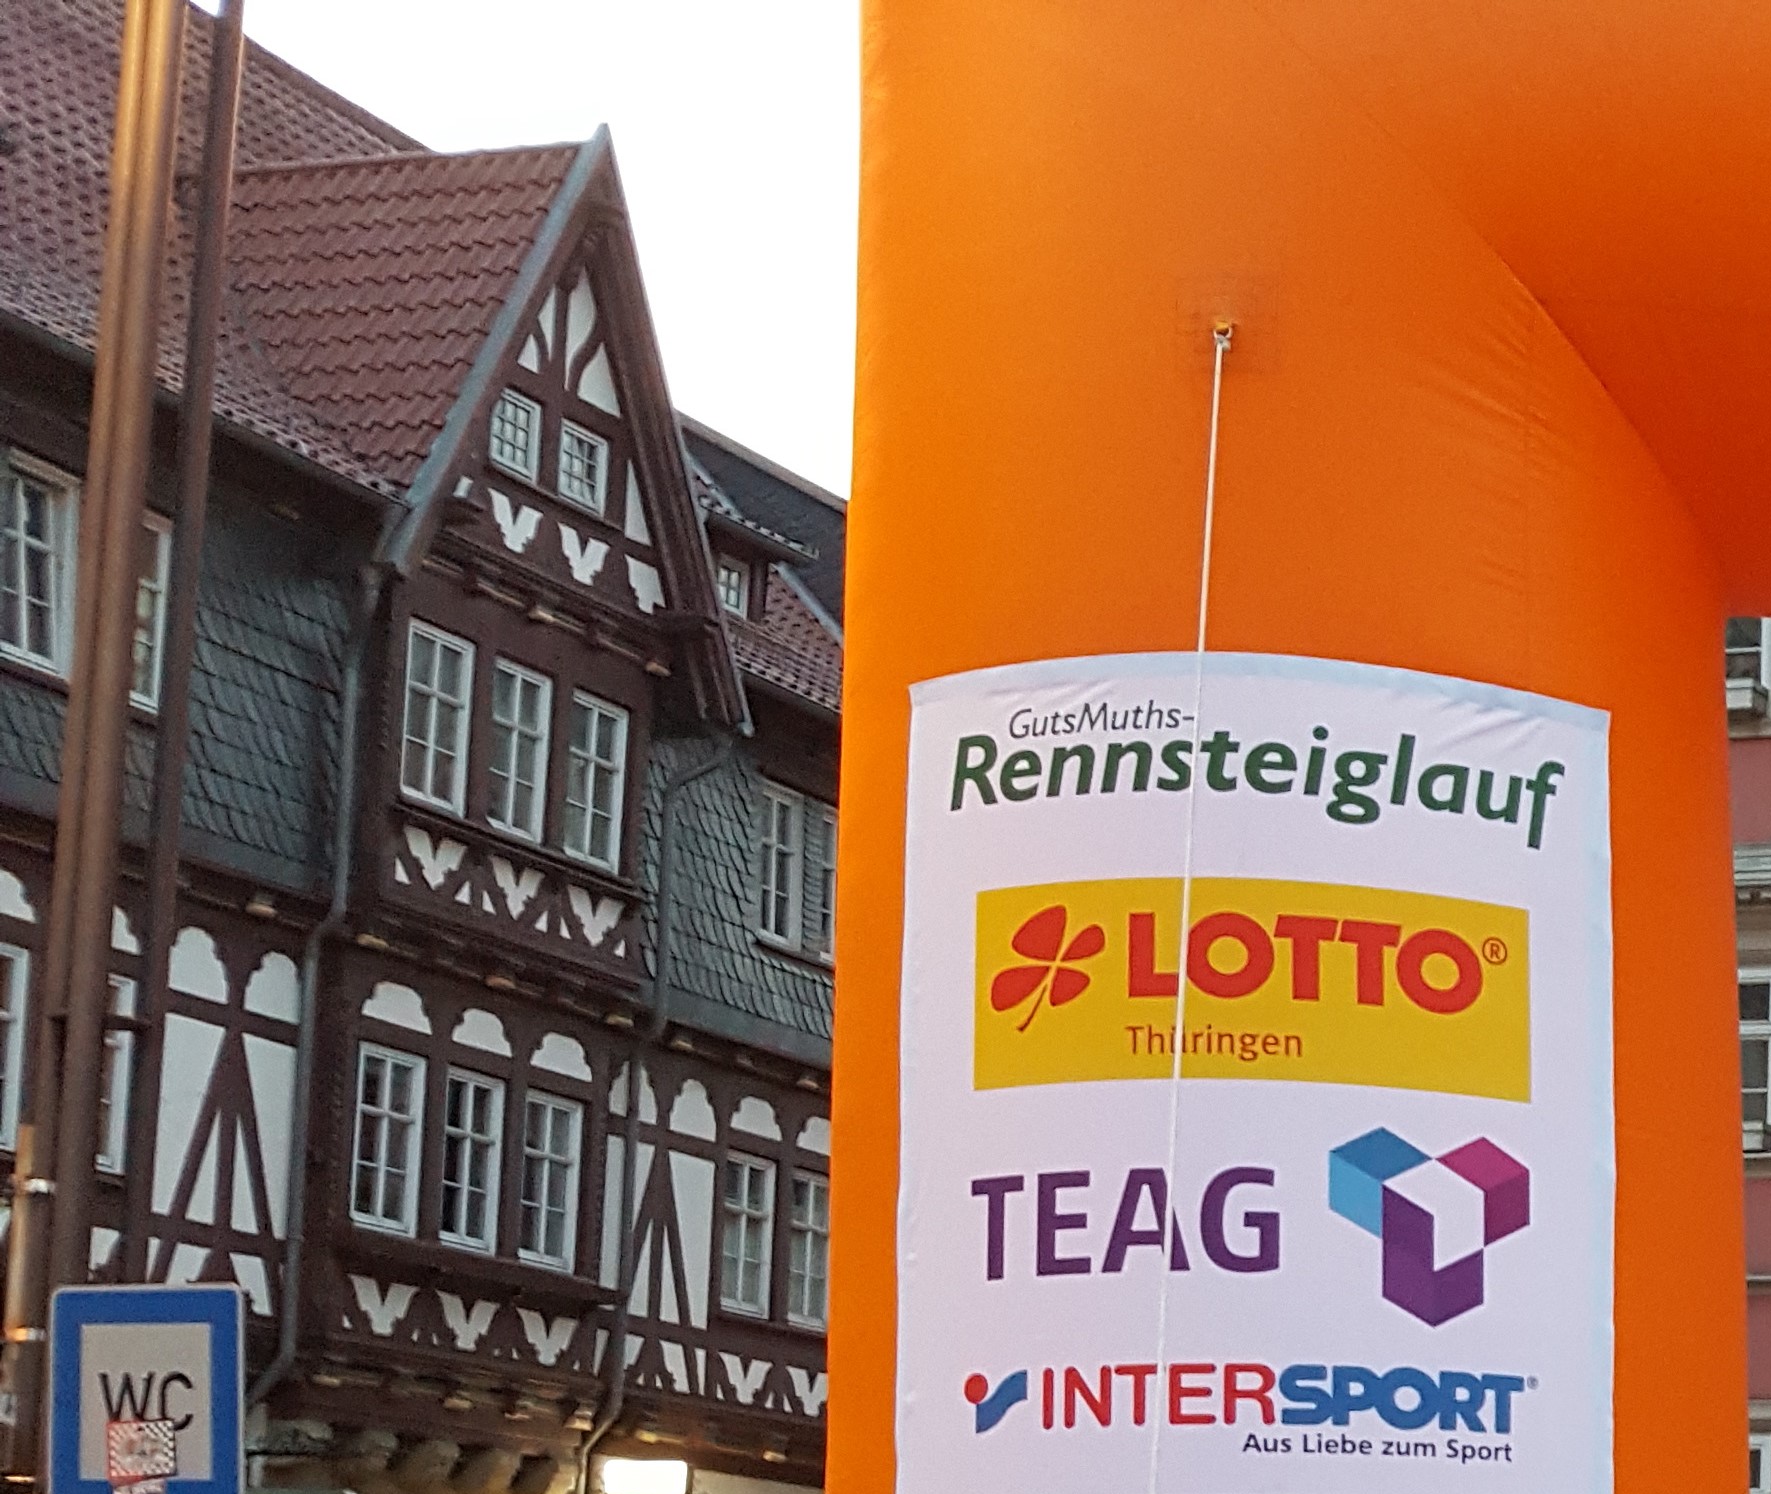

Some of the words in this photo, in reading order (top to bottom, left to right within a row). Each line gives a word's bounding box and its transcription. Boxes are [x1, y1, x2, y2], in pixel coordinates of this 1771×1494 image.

[1009, 699, 1195, 739] GutsMuths-
[950, 726, 1566, 850] Rennsteiglauf
[1126, 1025, 1303, 1061] Thüringen
[970, 1166, 1282, 1282] TEAG
[98, 1370, 194, 1432] WC
[1242, 1434, 1292, 1454] Aus
[1302, 1434, 1373, 1456] Liebe
[1382, 1441, 1437, 1458] zum
[1446, 1438, 1513, 1464] Sport
